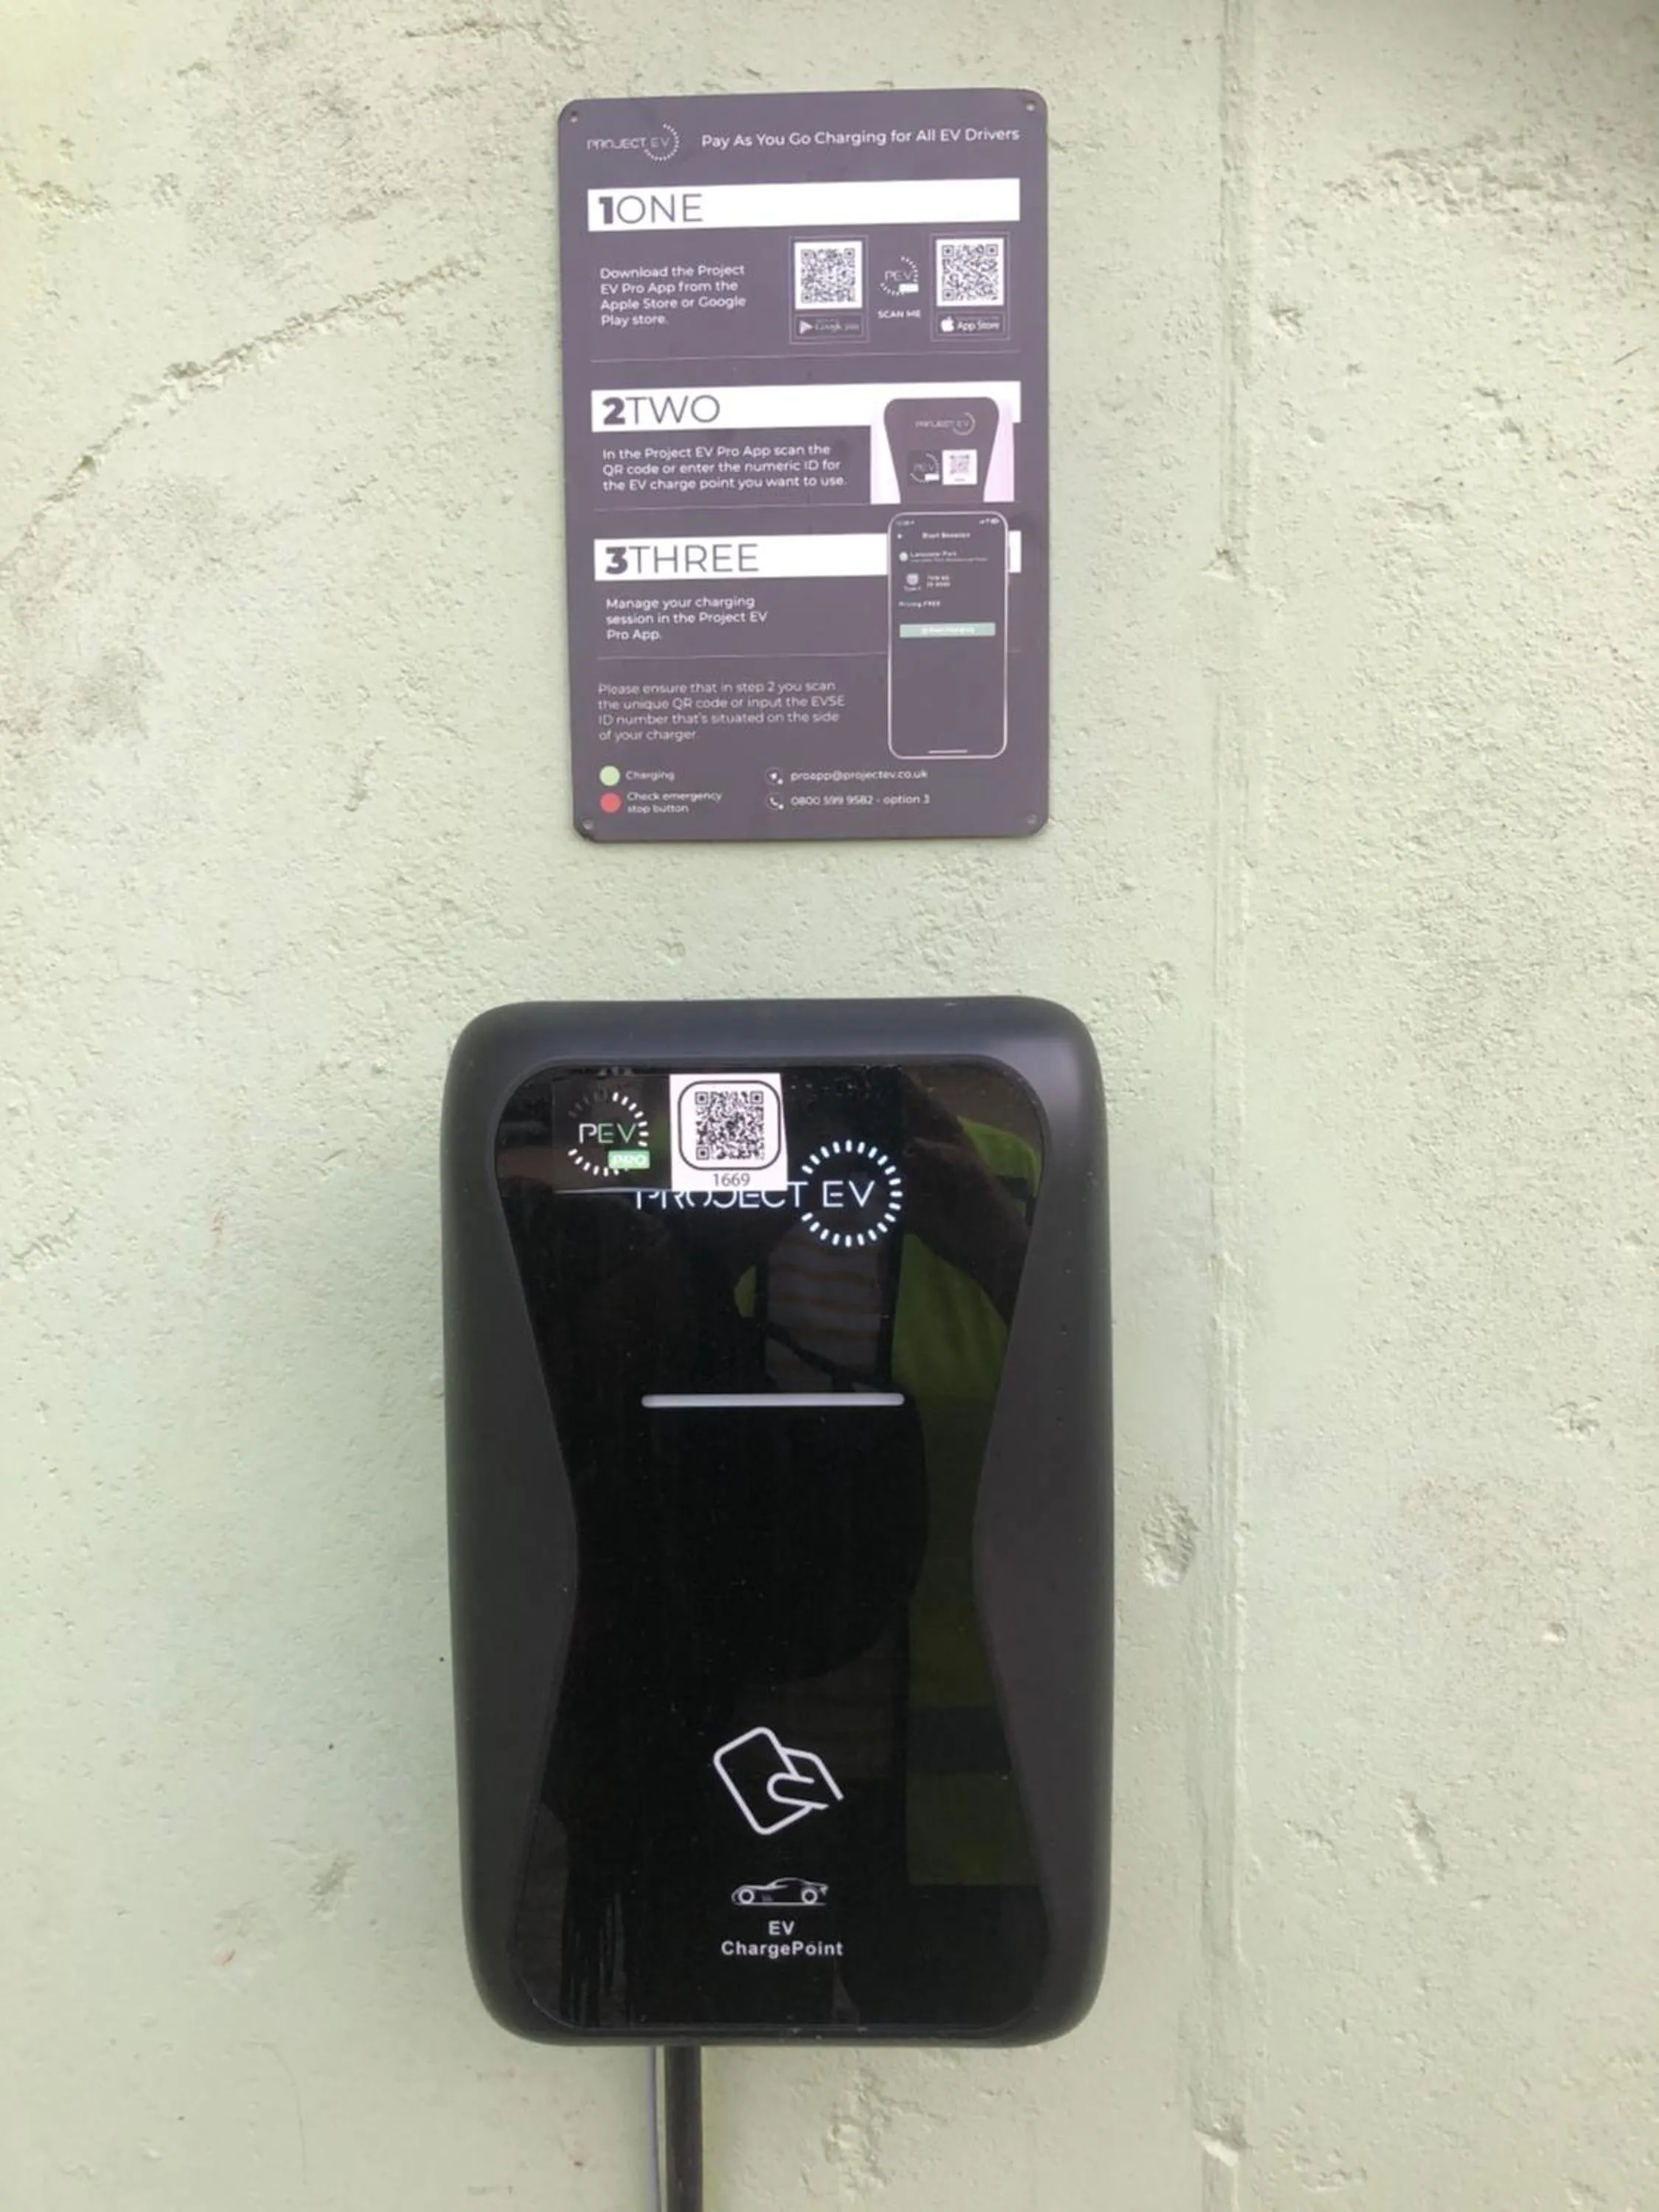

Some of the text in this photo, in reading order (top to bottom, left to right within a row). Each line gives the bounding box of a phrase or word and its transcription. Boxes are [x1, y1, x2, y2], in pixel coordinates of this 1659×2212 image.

[587, 137, 670, 150] PROJECT EV
[702, 128, 1020, 150] Pay As You Go Charging for All EV Drivers
[600, 265, 745, 279] Download the Project
[601, 280, 738, 294] EV Pro App from the
[601, 296, 746, 311] Apple Store or Google
[602, 315, 630, 328] Play
[878, 310, 921, 319] SCAN ME
[602, 445, 831, 461] In the Project EV Pro App scan the
[603, 459, 841, 477] QR code or enter the numeric ID for
[603, 476, 848, 493] the EV charge point you want to use.
[606, 597, 755, 611] Manage your charging
[606, 611, 768, 626] session in the Project EV
[607, 628, 661, 641] Pro App.
[598, 681, 836, 695] Please ensure that in step 2 you scan
[598, 695, 845, 712] the unique QR code or input the EVSE
[599, 712, 839, 726] ID number that's situated on the side
[599, 730, 611, 741] of
[614, 731, 642, 742] your
[625, 768, 675, 782] Charging
[627, 791, 723, 803] Check emergency
[790, 796, 821, 806] 0800
[883, 796, 920, 807] option
[922, 794, 931, 804] 3
[627, 804, 689, 814] stop button
[579, 1123, 636, 1144] PEV
[612, 1155, 647, 1164] PRO
[713, 1173, 751, 1187] 1669
[823, 1180, 875, 1208] EV
[768, 1921, 795, 1935] EV
[721, 1941, 844, 1958] ChargePoint
